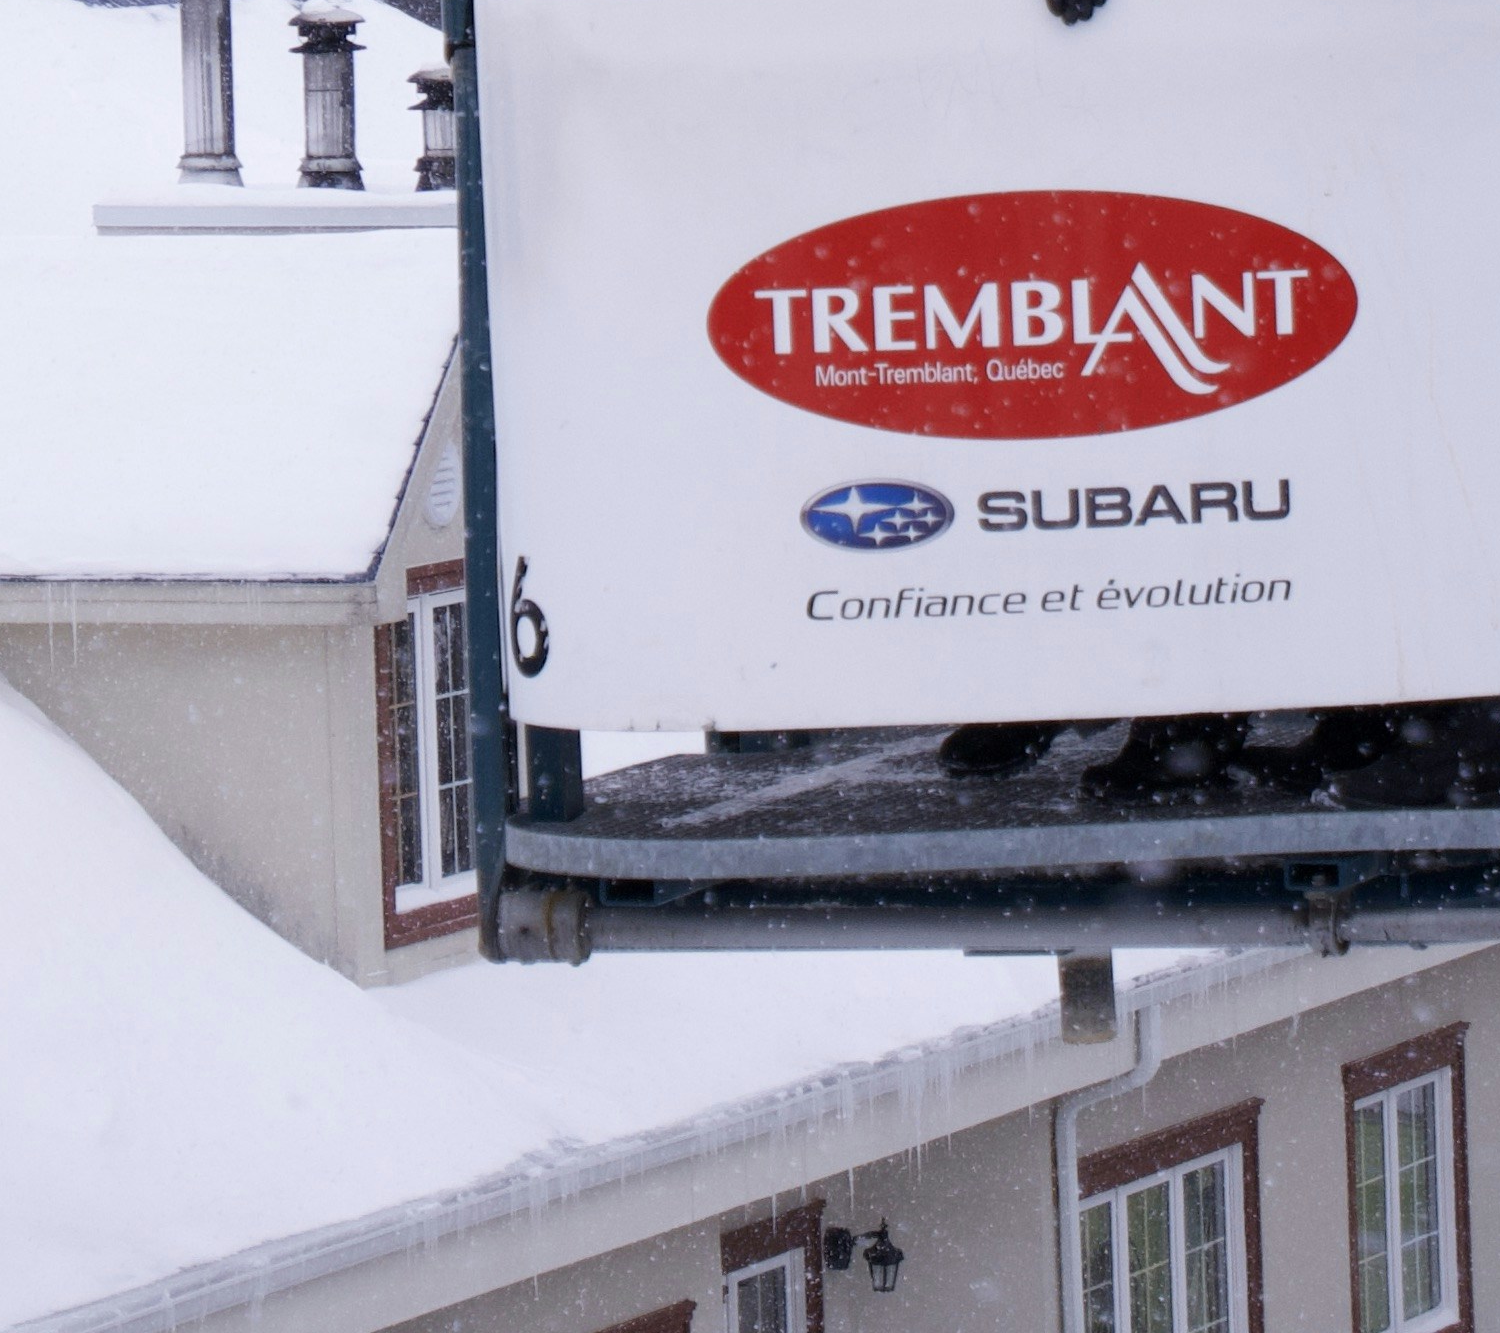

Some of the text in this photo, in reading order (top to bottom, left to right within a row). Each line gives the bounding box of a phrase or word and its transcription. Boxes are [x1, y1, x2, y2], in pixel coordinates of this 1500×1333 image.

[754, 261, 1309, 395] TREMBLANT
[814, 359, 1064, 387] Mont-Tremblant, Québec
[976, 478, 1292, 533] SUBARU
[510, 555, 549, 679] 6
[805, 573, 1292, 621] Confiance et évolution
